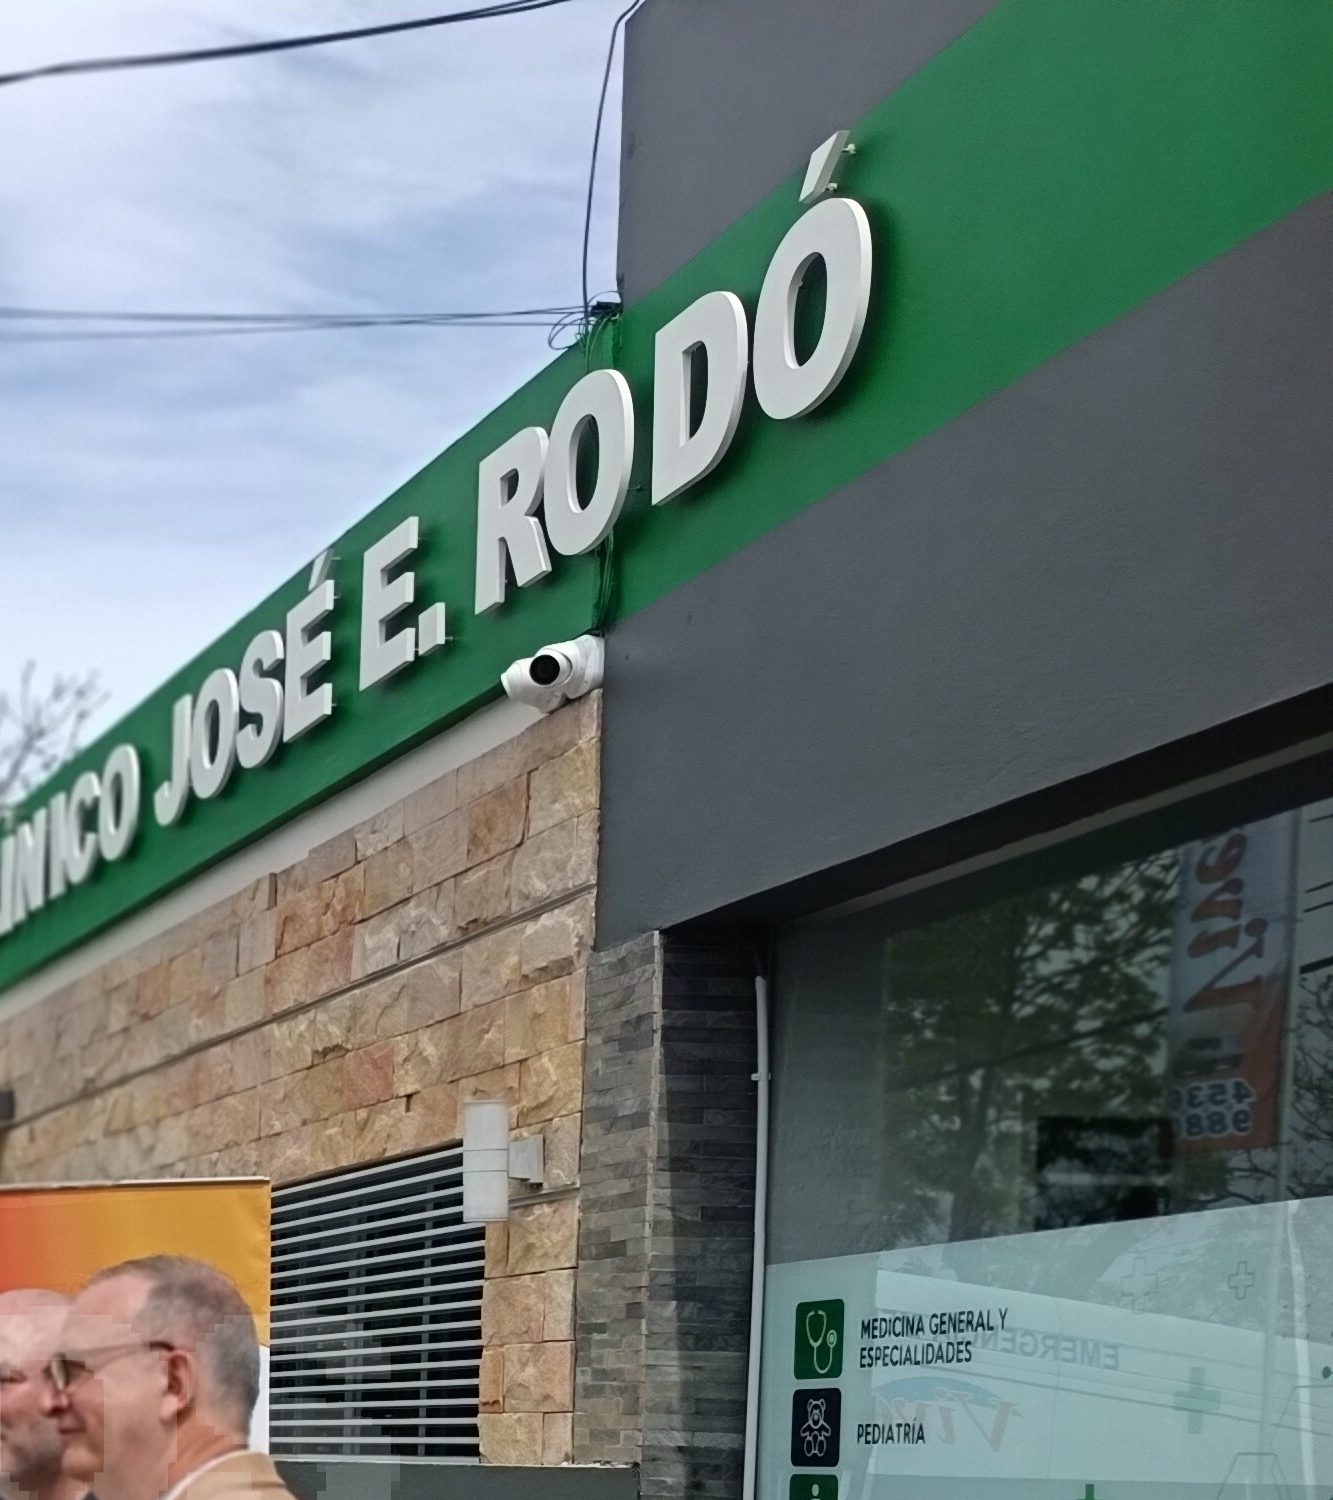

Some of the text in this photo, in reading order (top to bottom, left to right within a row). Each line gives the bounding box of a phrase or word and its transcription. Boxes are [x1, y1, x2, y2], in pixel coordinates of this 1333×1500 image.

[154, 548, 335, 827] JOSÉ
[359, 515, 445, 692] E.
[475, 129, 873, 615] RODÓ
[860, 1307, 1009, 1340] MEDICINA GENERAL Y
[859, 1340, 973, 1369] ESPECIALIDADES
[857, 1416, 926, 1445] PEDIATRÍA
